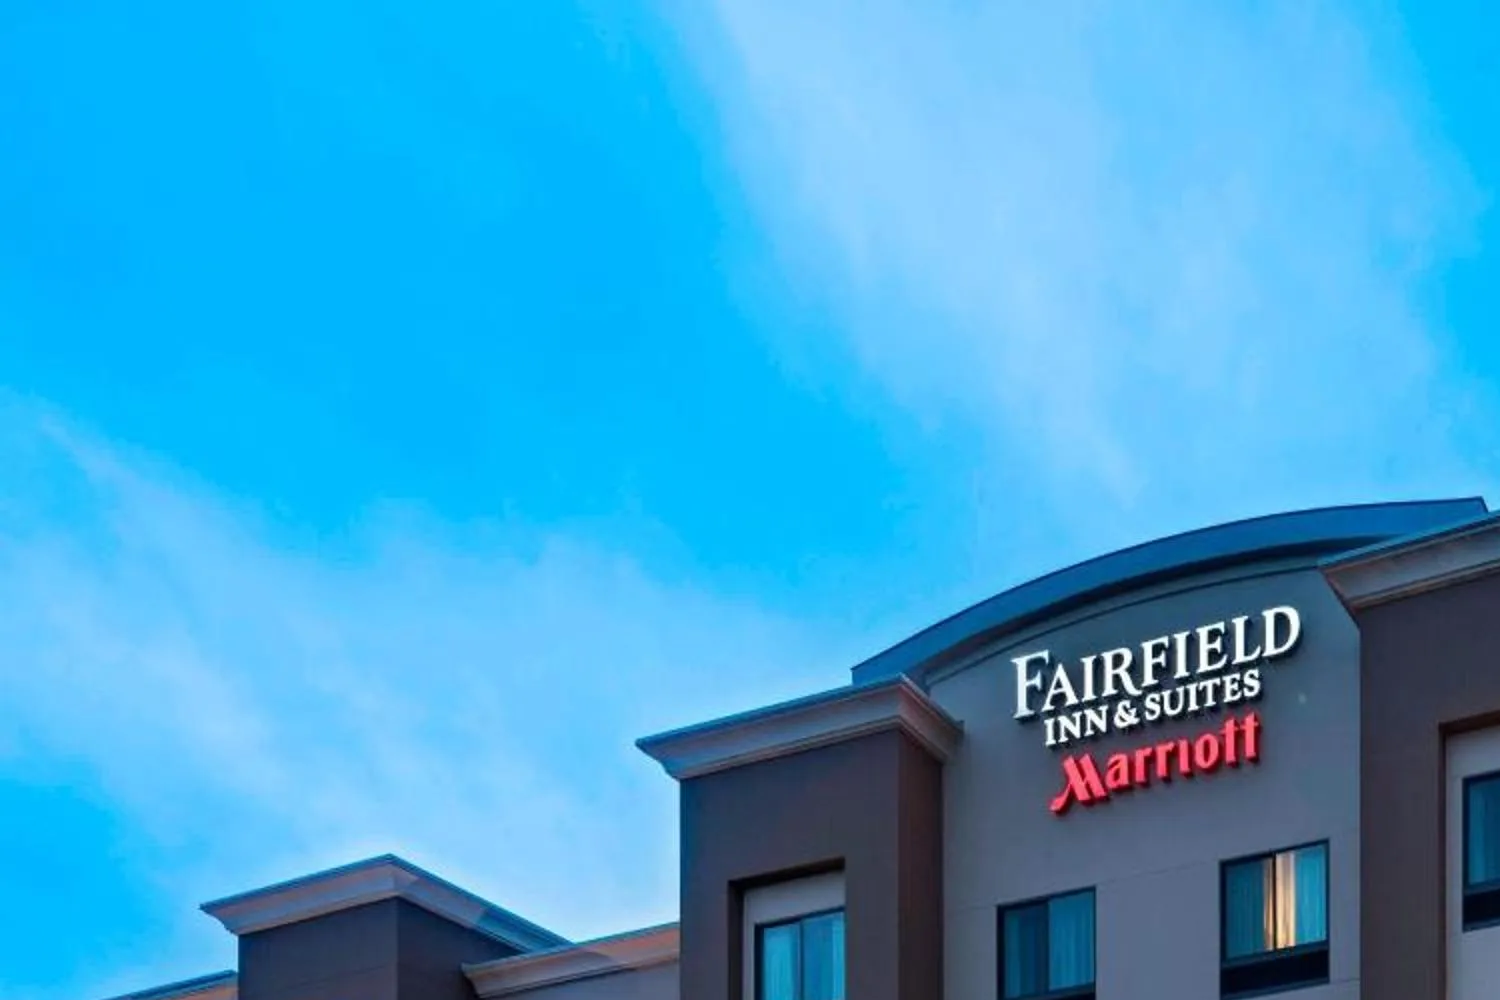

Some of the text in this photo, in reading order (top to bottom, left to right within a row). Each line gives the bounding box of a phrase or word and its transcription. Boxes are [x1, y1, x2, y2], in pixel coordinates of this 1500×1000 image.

[1010, 605, 1301, 719] FAIRFIELD
[1043, 669, 1262, 746] INN & SUITES
[1049, 711, 1261, 814] Marriott
